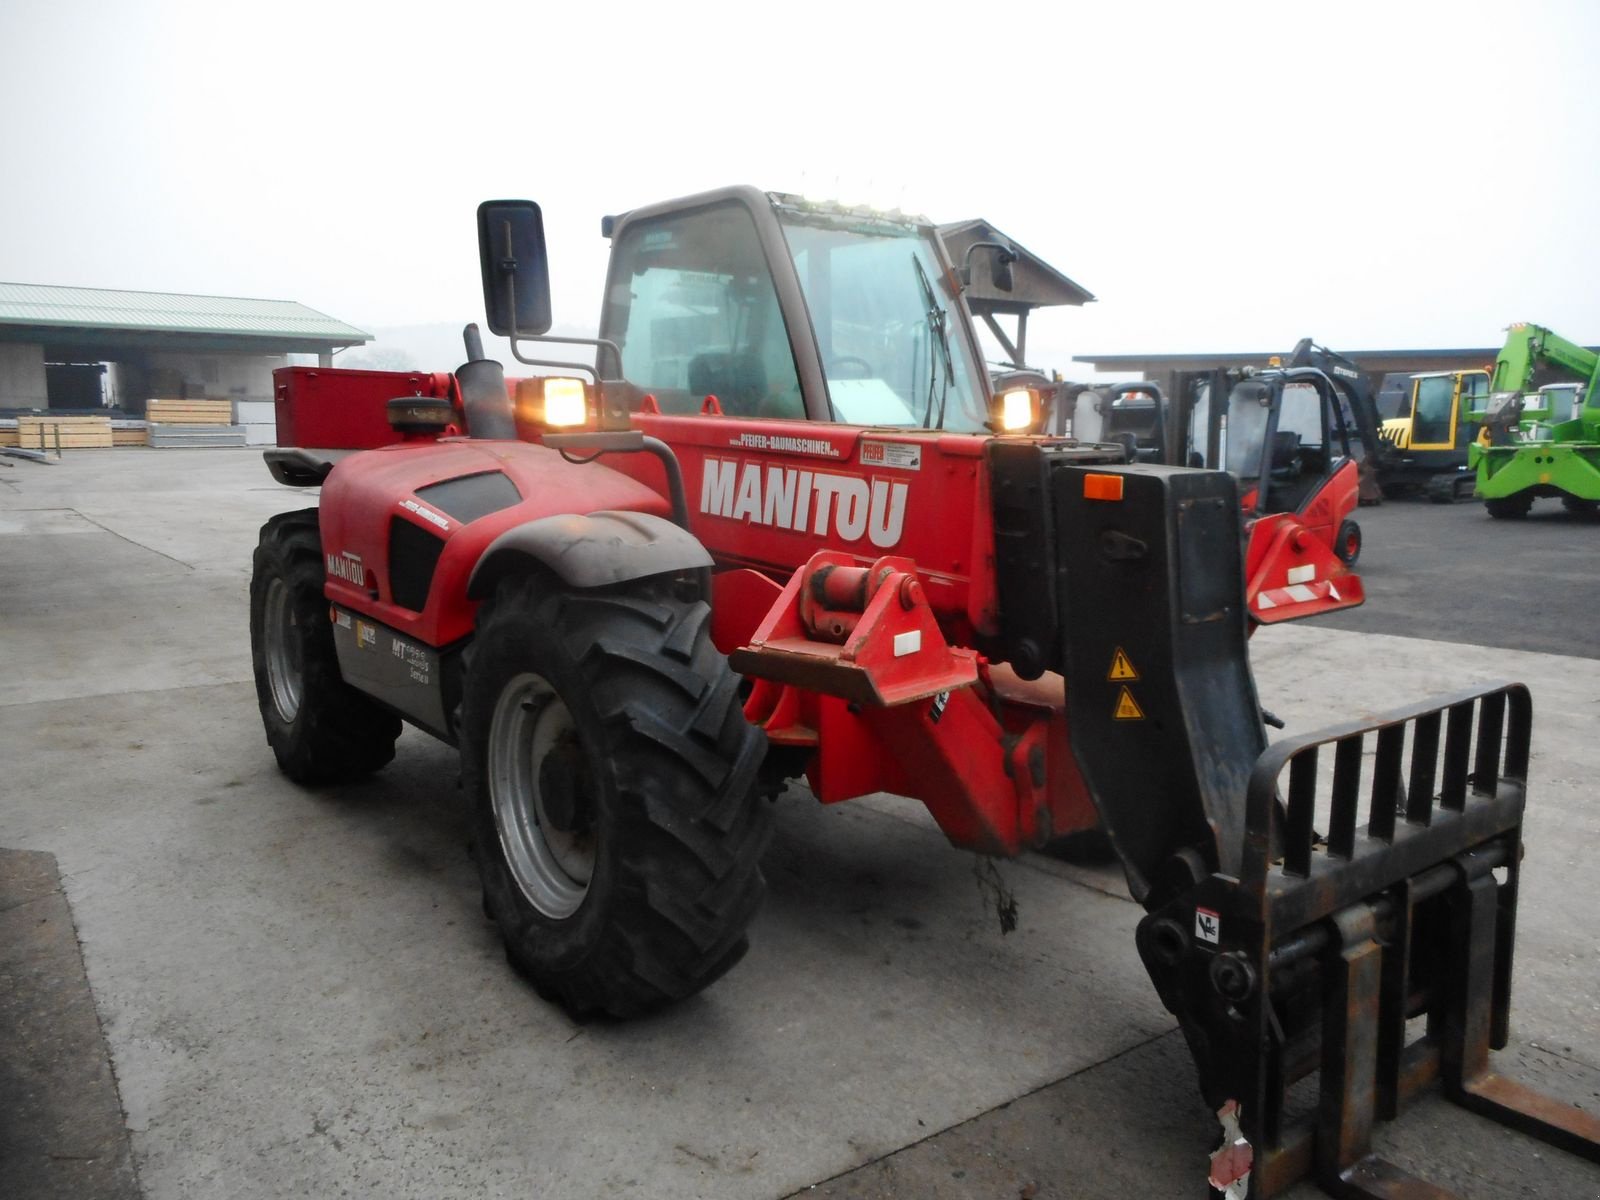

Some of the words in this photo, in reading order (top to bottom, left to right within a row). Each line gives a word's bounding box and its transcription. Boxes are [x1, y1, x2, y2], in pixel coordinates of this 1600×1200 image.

[700, 458, 909, 548] MANITOU
[327, 551, 364, 586] MANITOU
[392, 638, 406, 659] MT
